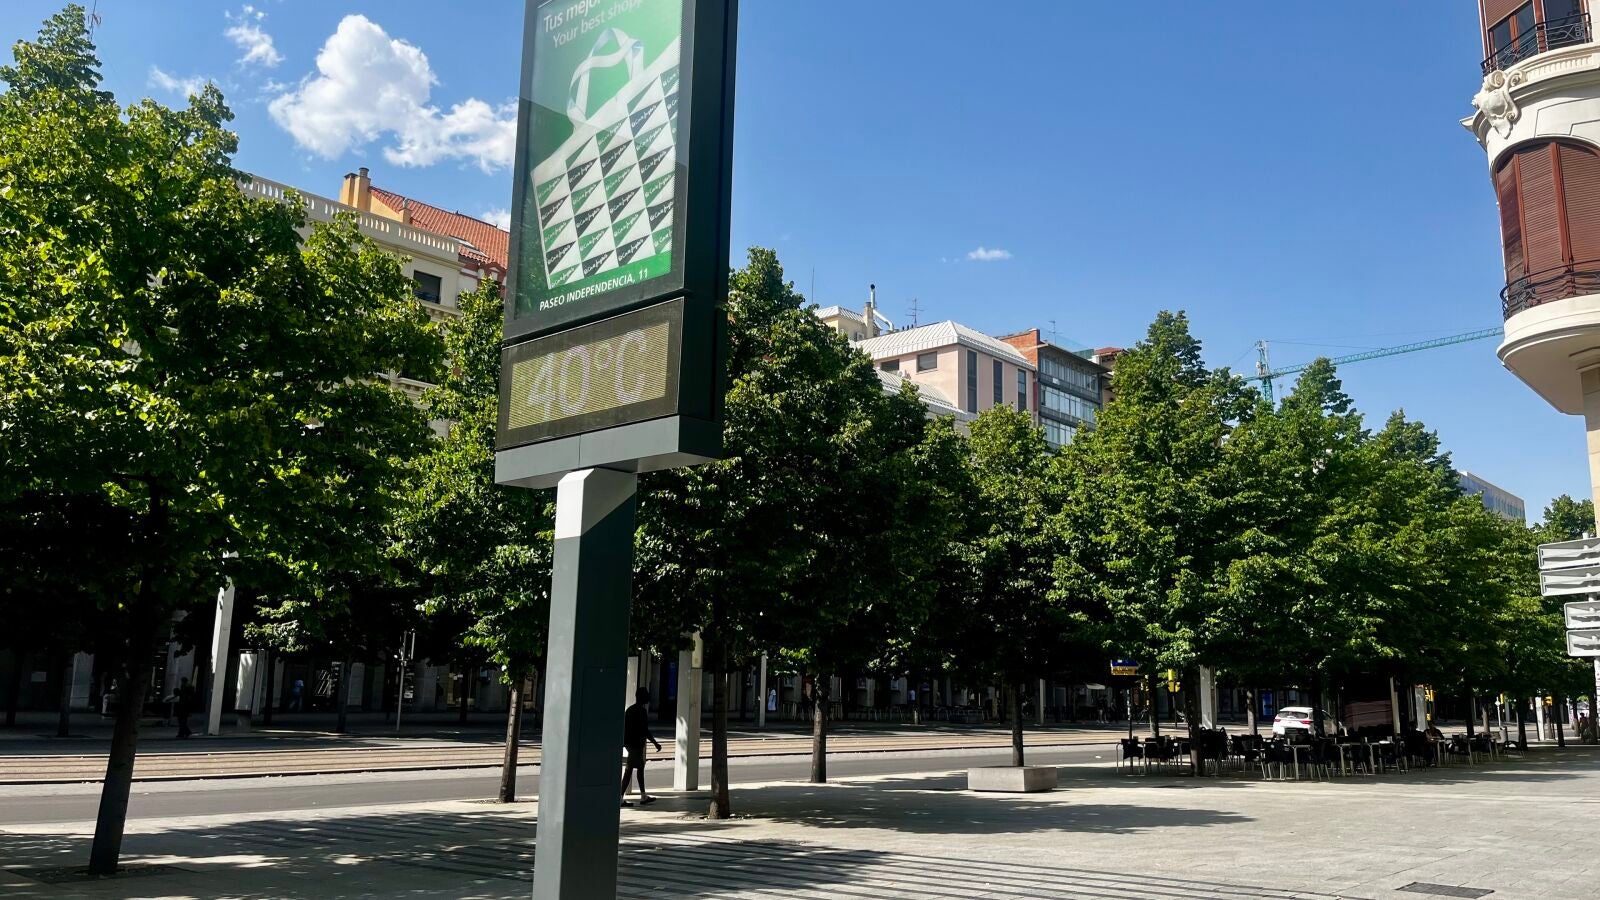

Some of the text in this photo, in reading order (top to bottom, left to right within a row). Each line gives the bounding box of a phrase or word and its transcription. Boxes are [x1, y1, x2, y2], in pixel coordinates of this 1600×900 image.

[543, 0, 600, 32] Tus mejo
[553, 26, 578, 48] Your
[581, 11, 605, 33] best
[539, 296, 565, 311] PASEO
[567, 273, 635, 302] INDEPENDENCIA,
[639, 268, 648, 280] 11
